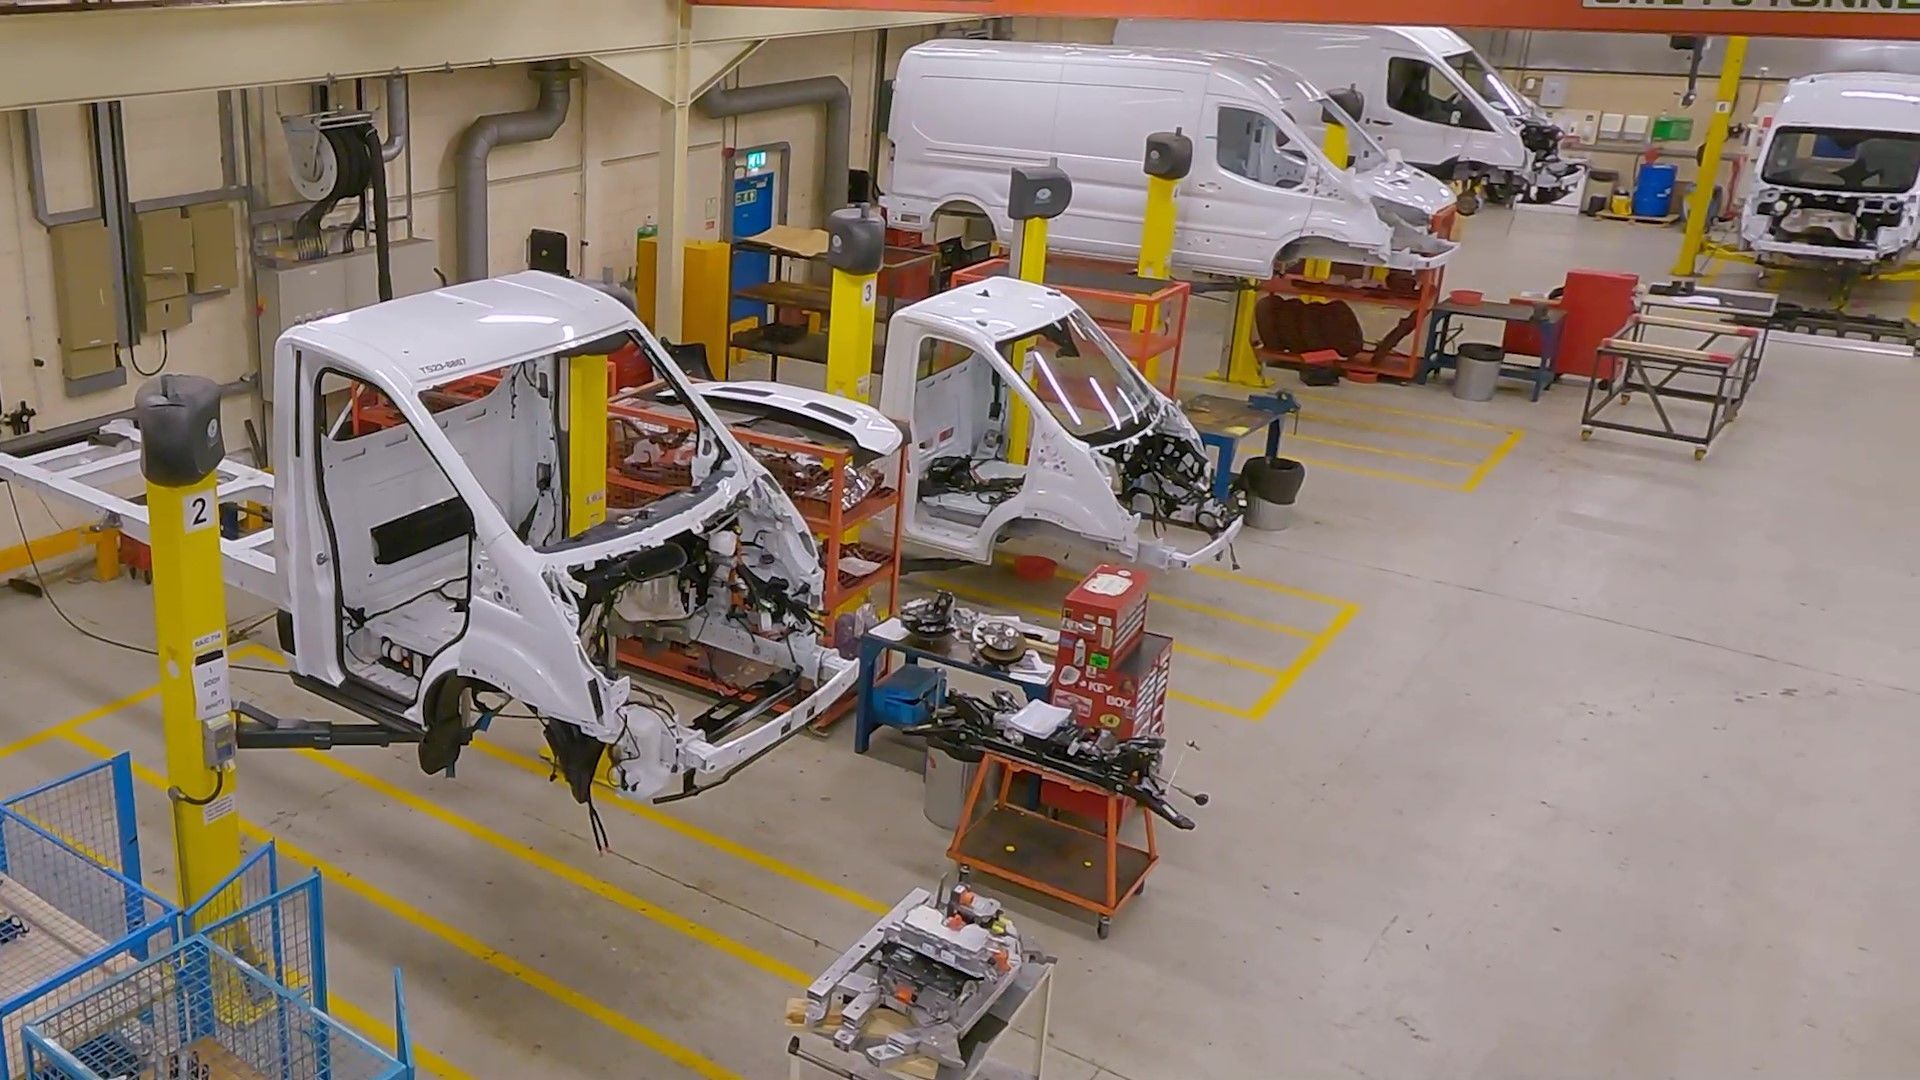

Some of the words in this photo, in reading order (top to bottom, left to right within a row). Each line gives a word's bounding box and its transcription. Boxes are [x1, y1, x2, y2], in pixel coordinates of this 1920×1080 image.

[865, 284, 872, 302] 3
[192, 498, 207, 525] 2
[1088, 681, 1113, 693] KEY
[1106, 695, 1132, 708] BOY
